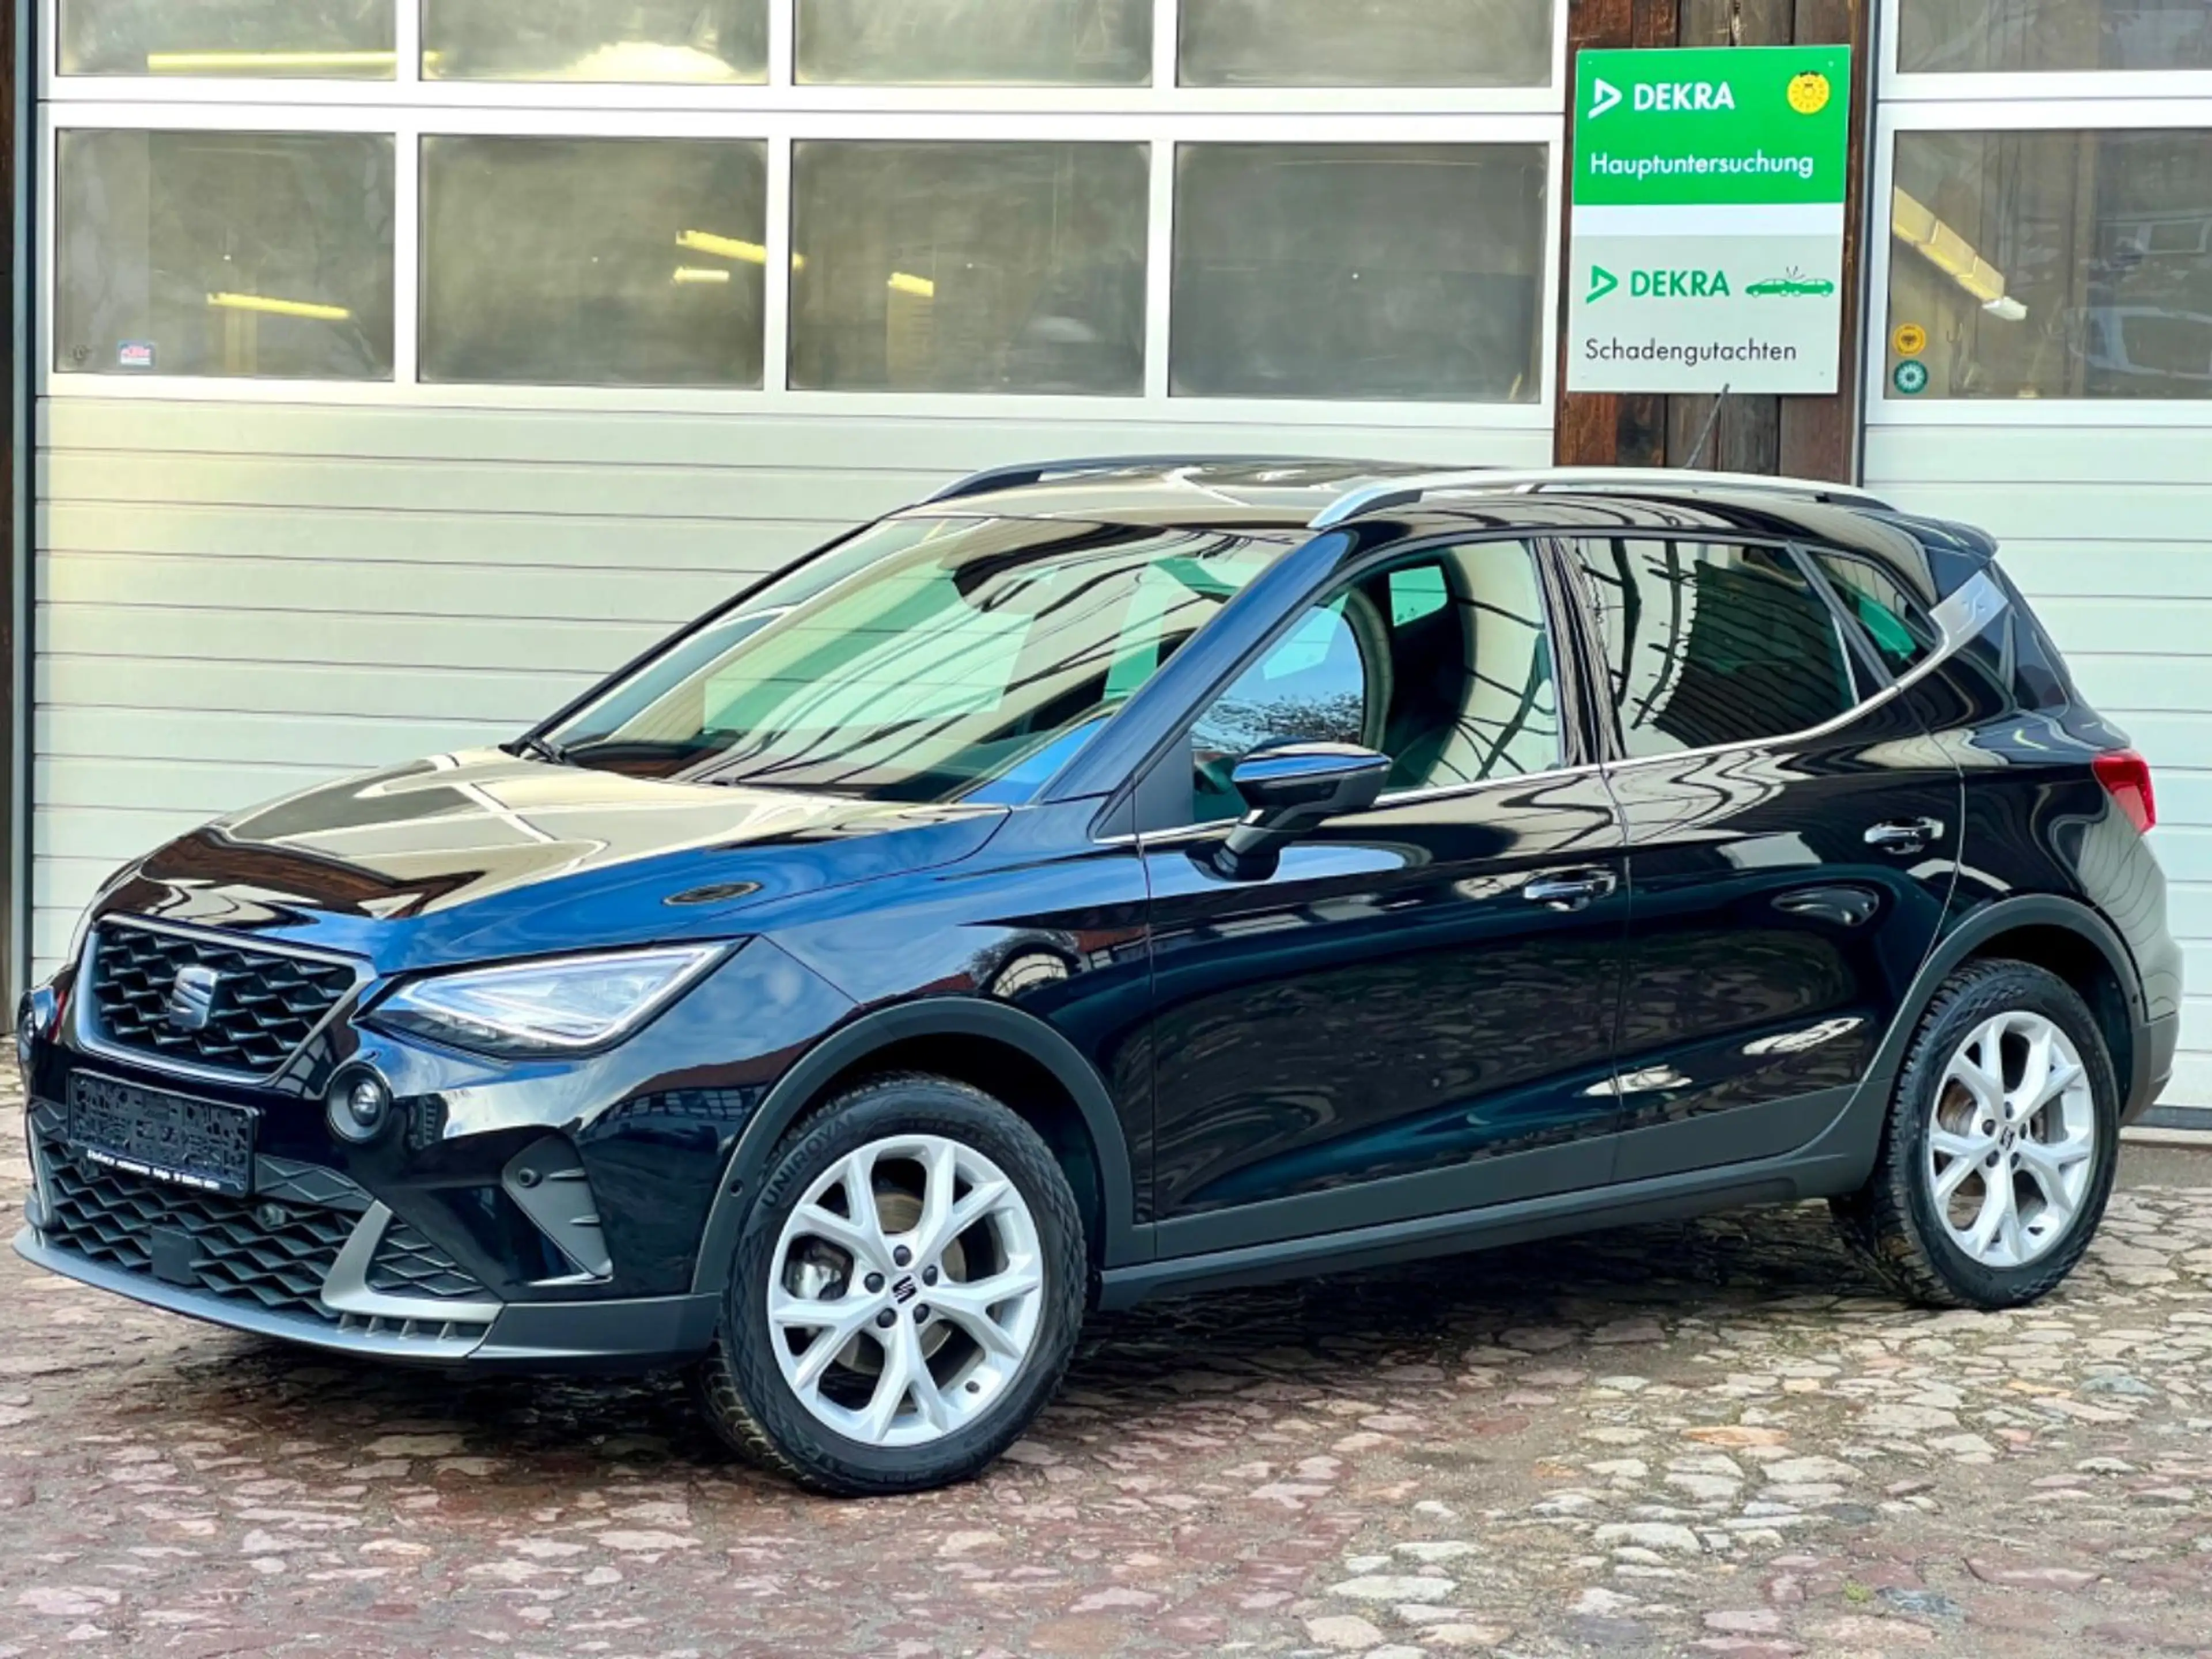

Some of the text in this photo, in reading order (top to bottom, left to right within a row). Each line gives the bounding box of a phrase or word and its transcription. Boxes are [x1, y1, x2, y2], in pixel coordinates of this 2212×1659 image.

[1633, 81, 1736, 111] DEKRA
[1590, 149, 1814, 180] Hauptuntersuchung
[1630, 270, 1730, 297] DEKRA
[1585, 336, 1797, 367] Schadengutachten
